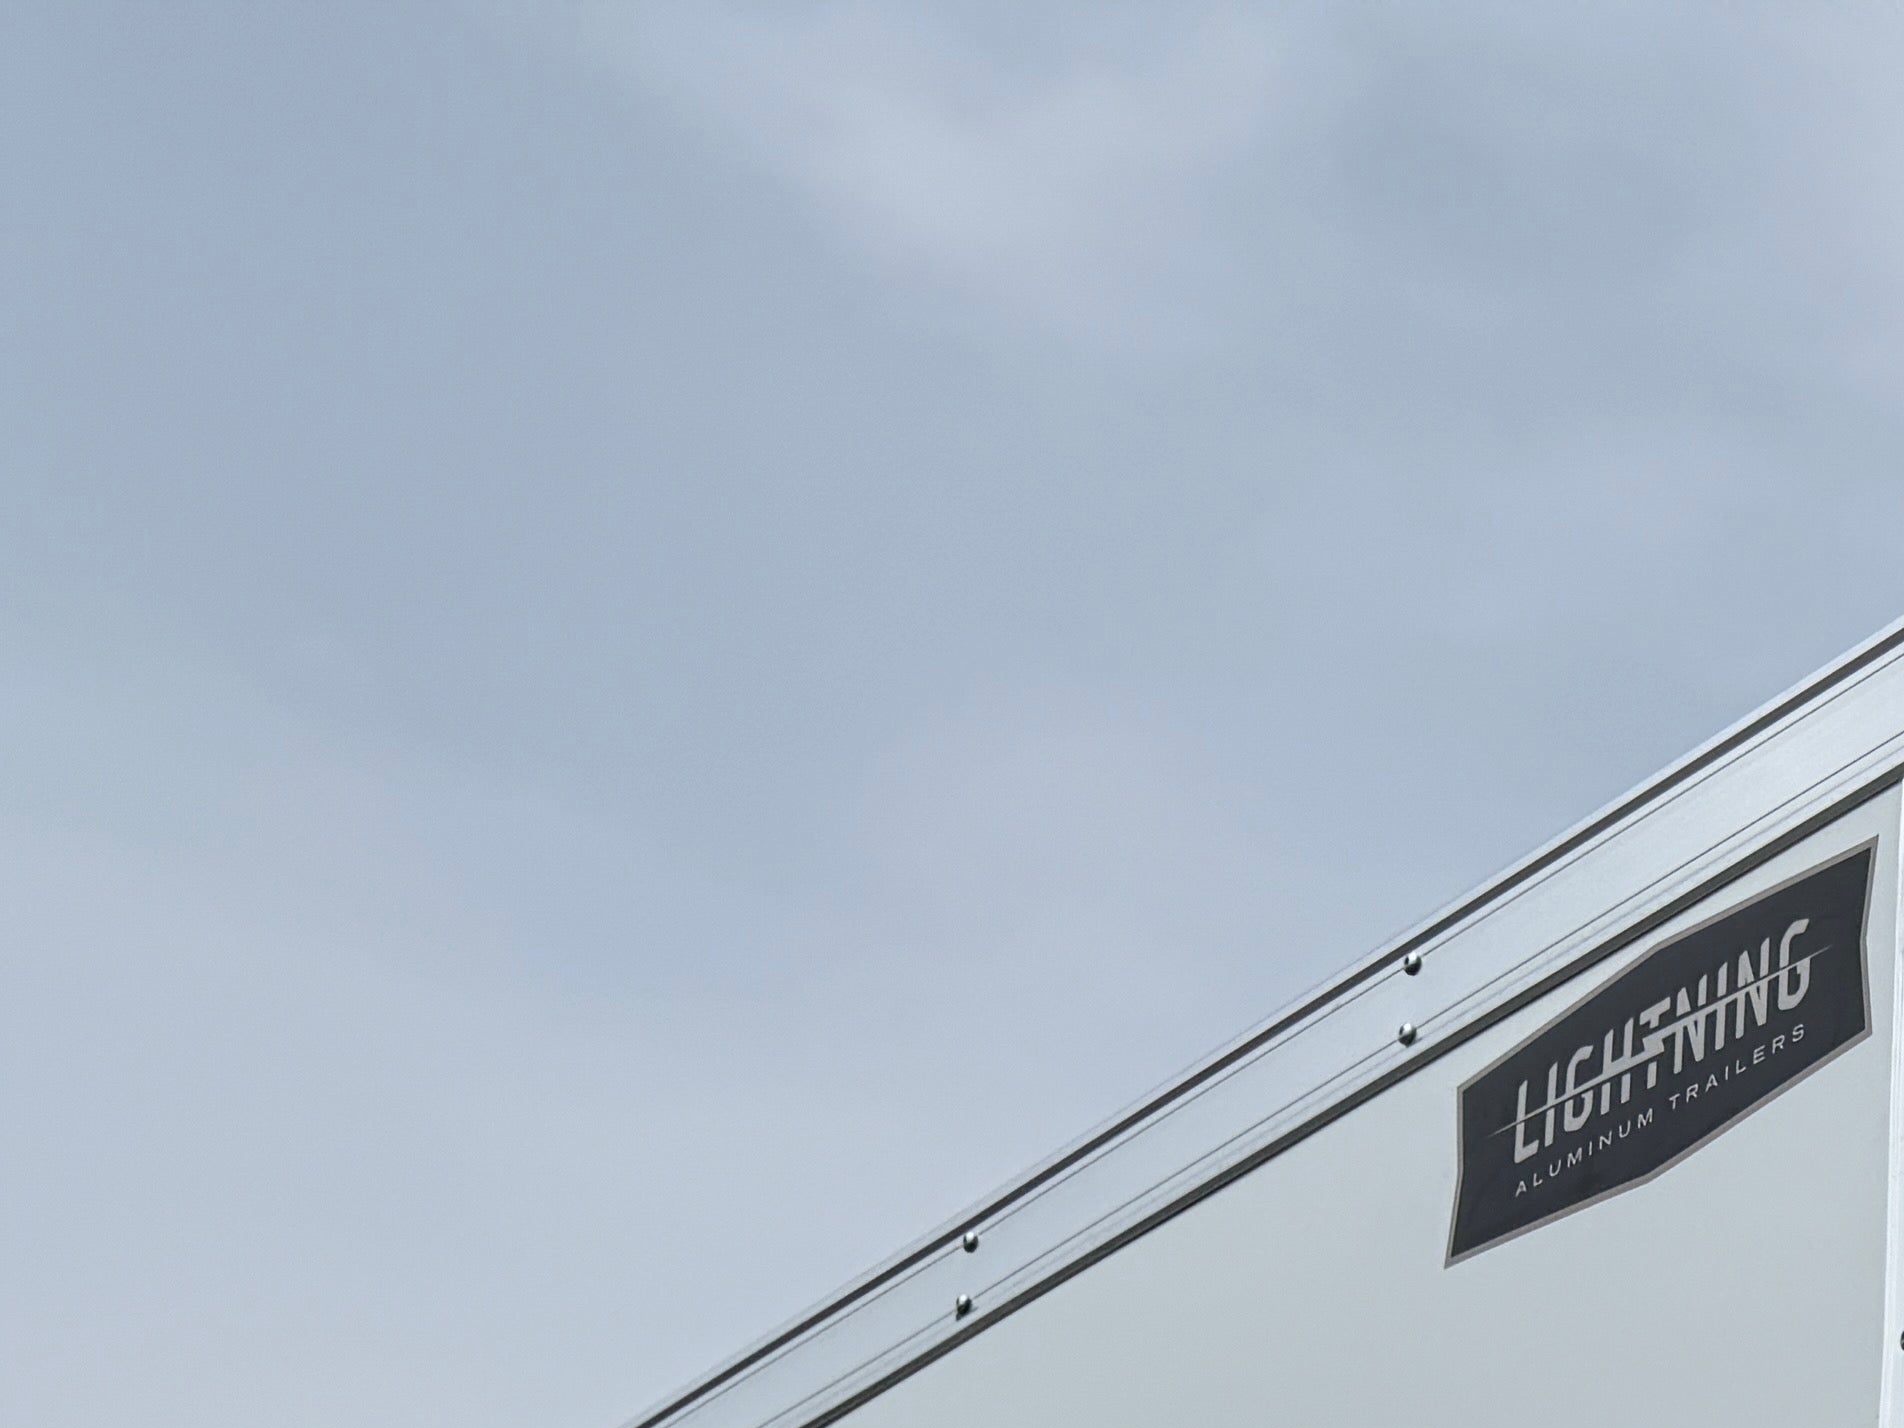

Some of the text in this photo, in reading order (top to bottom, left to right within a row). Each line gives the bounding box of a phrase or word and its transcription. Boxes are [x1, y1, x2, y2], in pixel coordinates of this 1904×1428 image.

[1513, 918, 1811, 1165] LIGHTNING
[1514, 1023, 1806, 1198] ALUMINUM TRAILERS
